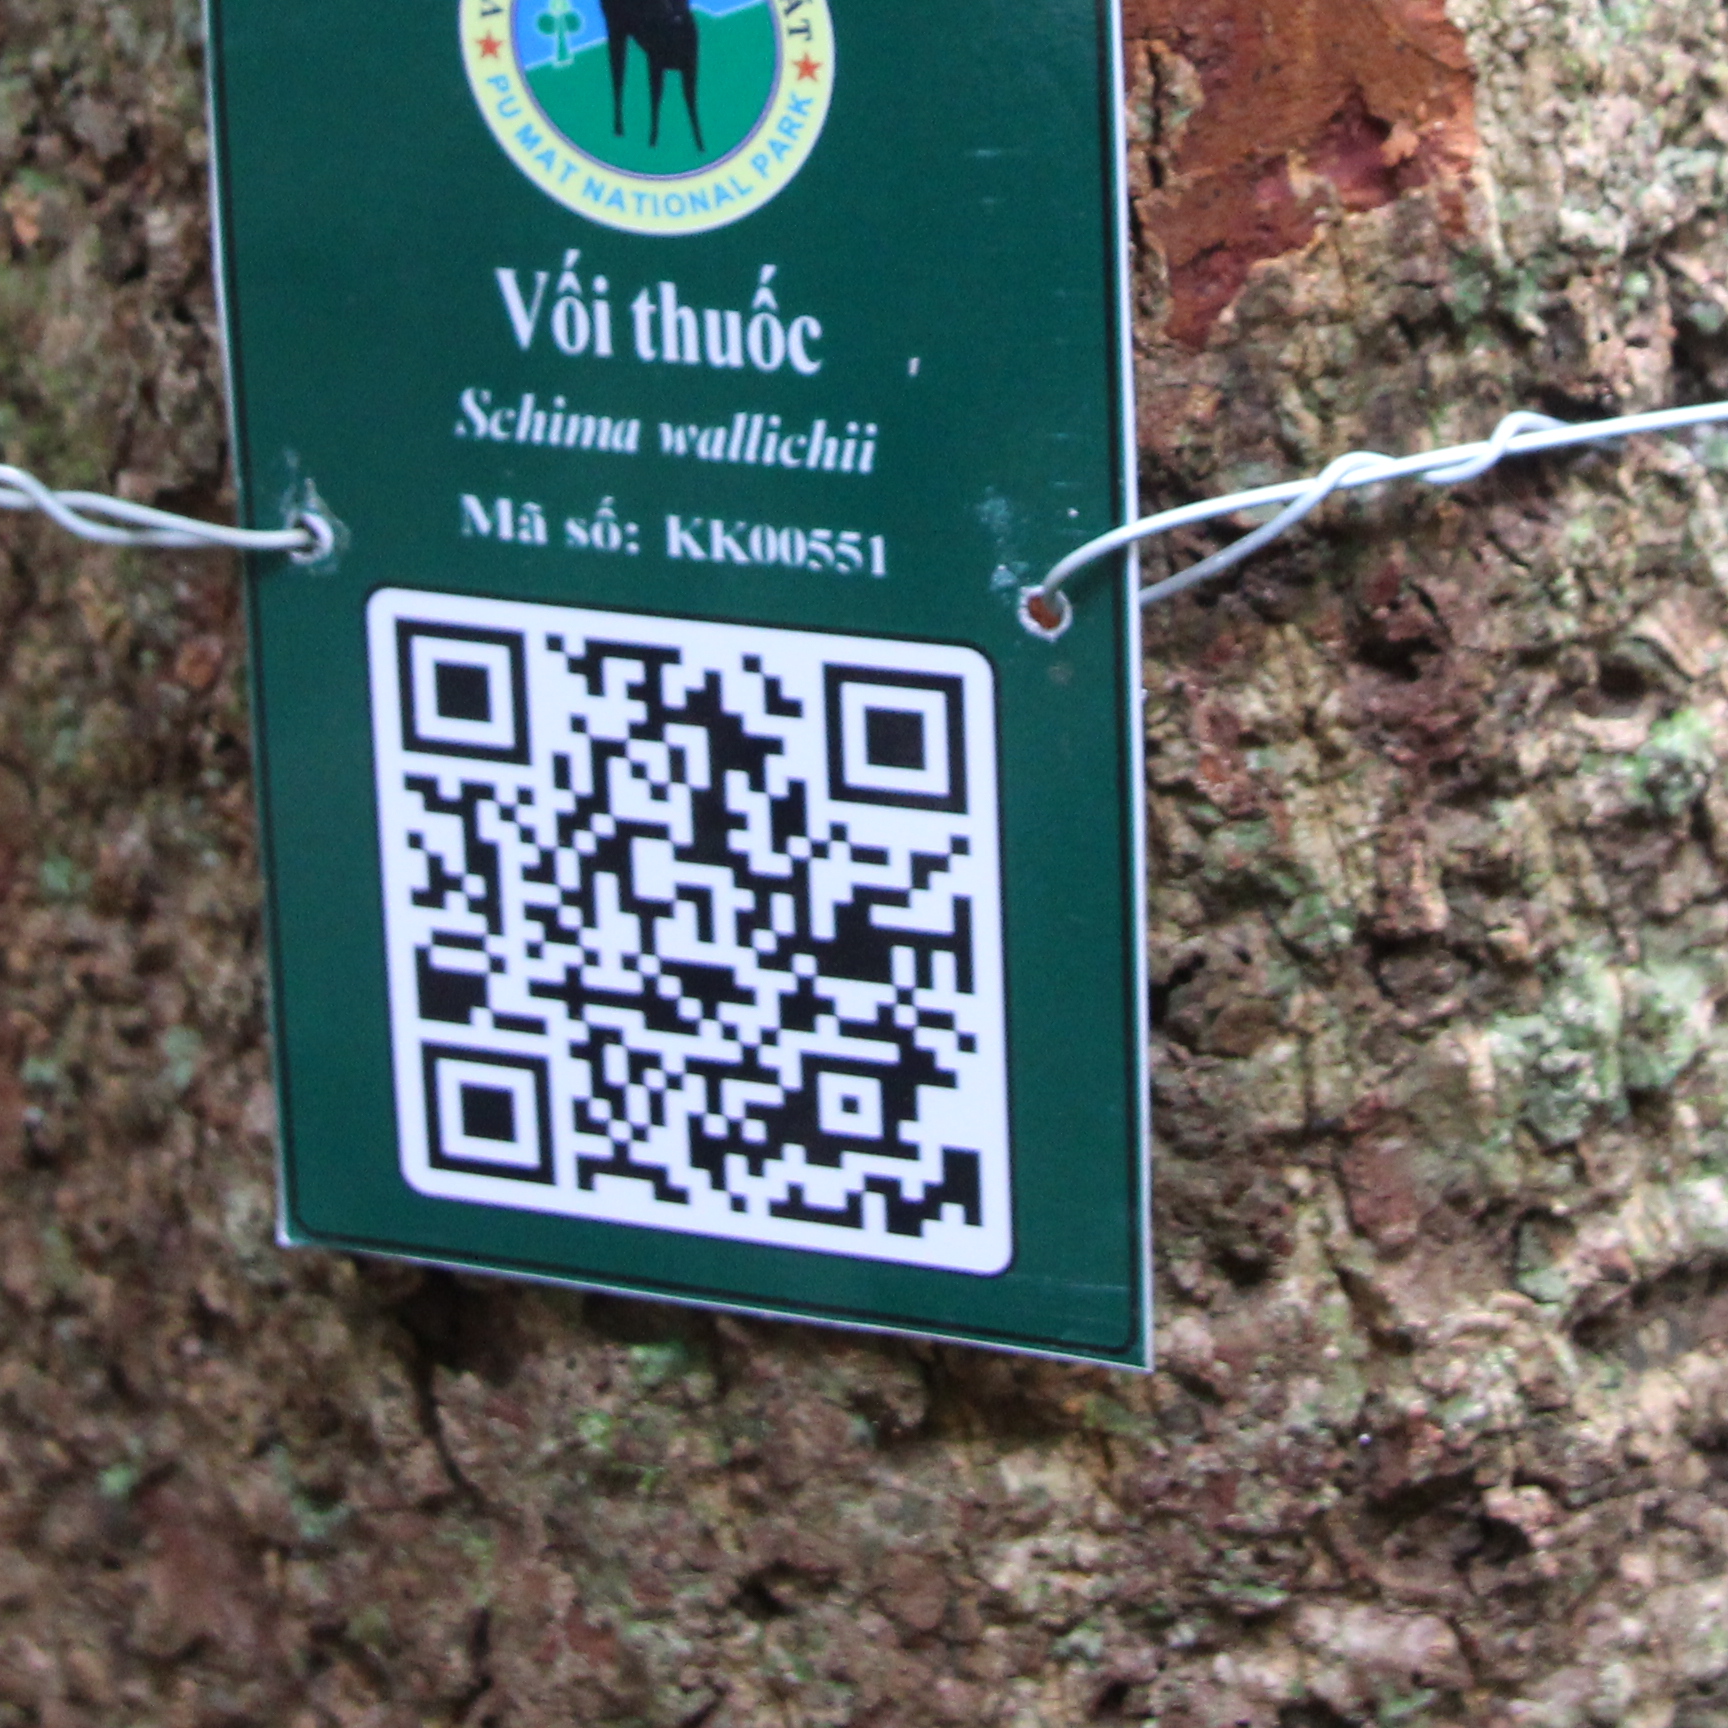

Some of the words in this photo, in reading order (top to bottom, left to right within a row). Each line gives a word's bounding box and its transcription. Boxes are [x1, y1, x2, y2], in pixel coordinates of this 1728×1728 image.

[485, 73, 522, 120] PU
[515, 124, 579, 185] MAT
[581, 175, 754, 219] NATIONAL
[750, 92, 814, 179] PARK
[495, 248, 613, 357] Vối
[631, 263, 823, 375] thuốc
[454, 386, 640, 454] Schima
[657, 411, 878, 474] wallichii
[460, 493, 548, 546] Mã
[565, 494, 640, 556] số:
[665, 513, 887, 578] KK00551
